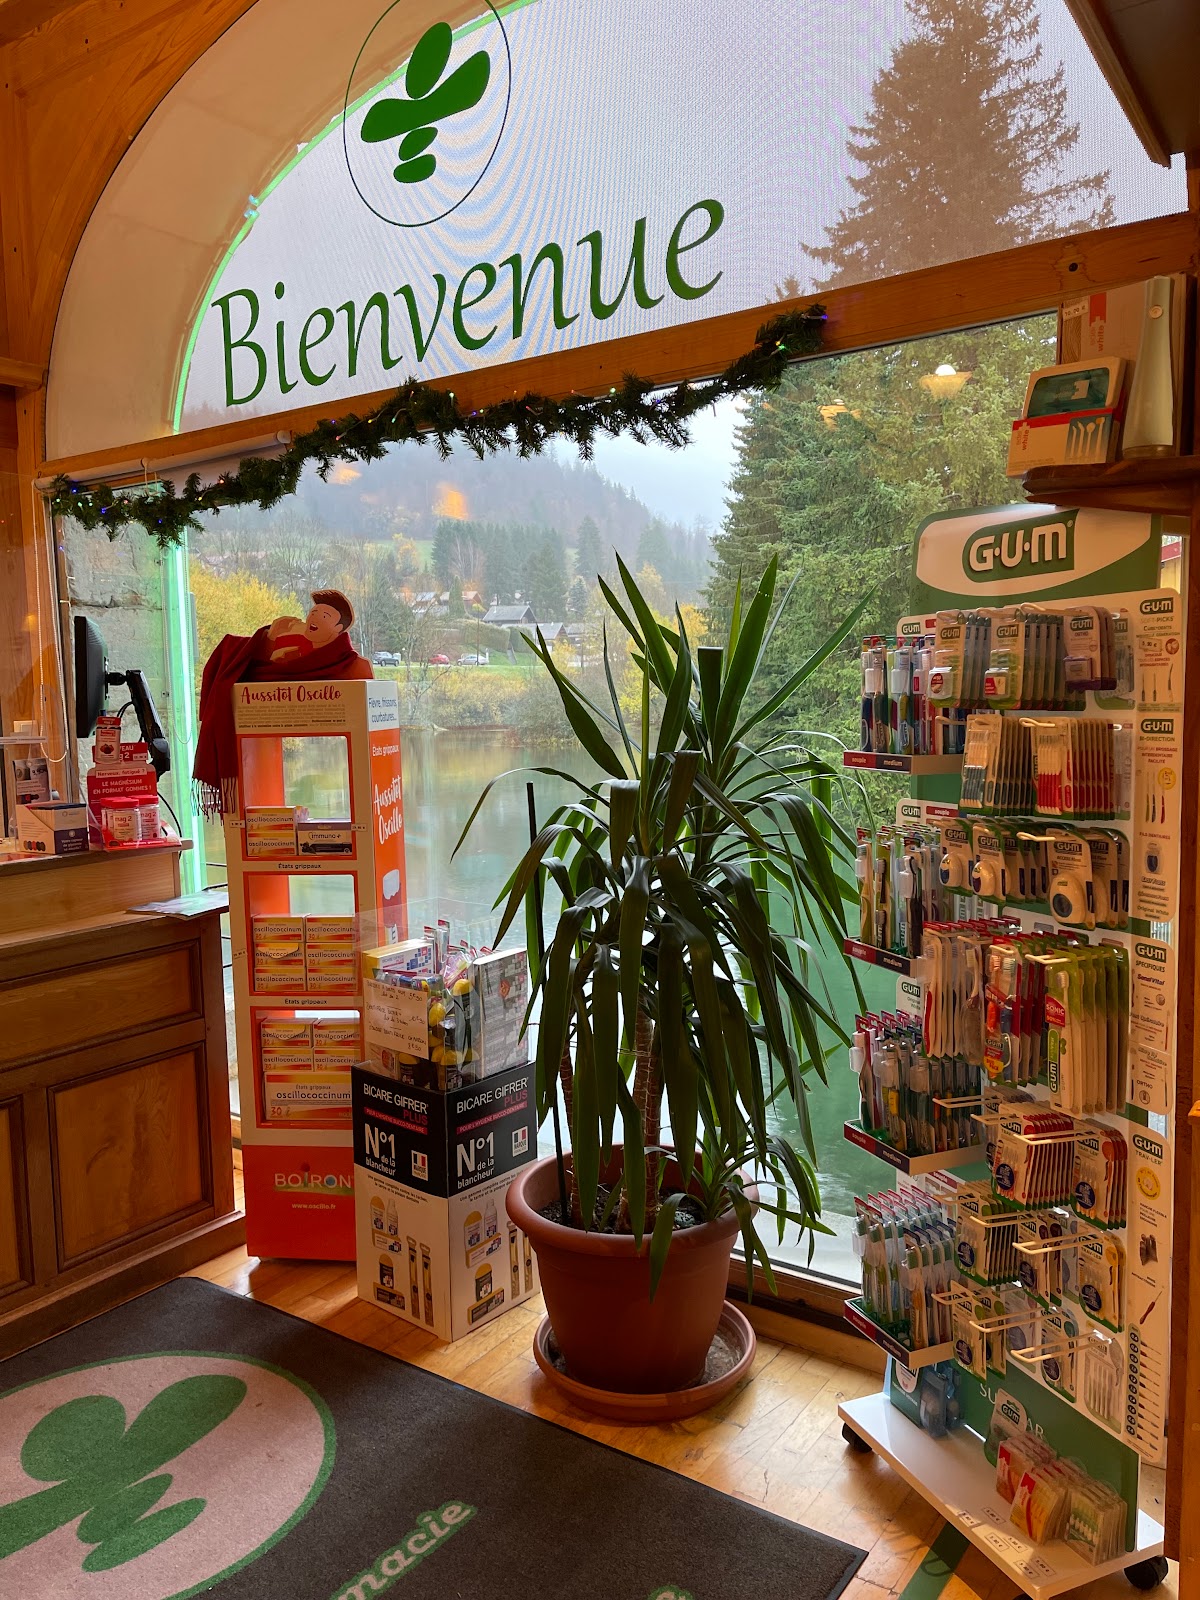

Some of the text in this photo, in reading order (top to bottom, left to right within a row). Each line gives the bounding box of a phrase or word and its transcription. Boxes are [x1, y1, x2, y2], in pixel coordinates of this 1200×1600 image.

[211, 199, 725, 408] Bienvenue
[241, 685, 342, 705] Aussitôt Oscillo
[374, 775, 401, 815] Aussitôt
[378, 806, 403, 845] Oscillo
[1046, 1003, 1065, 1016] SONIC
[276, 1091, 351, 1099] oscillococcinum
[363, 1083, 427, 1115] BICARE GIFRER
[456, 1077, 528, 1114] BICARE GIFRER
[504, 1089, 528, 1107] PLUS
[270, 1106, 282, 1116] 30
[403, 1109, 428, 1126] PLUS
[365, 1156, 396, 1177] blancheur
[380, 1154, 396, 1168] de la
[477, 1157, 495, 1171] de la
[274, 1171, 352, 1189] BOIRON
[457, 1168, 495, 1189] blancheur
